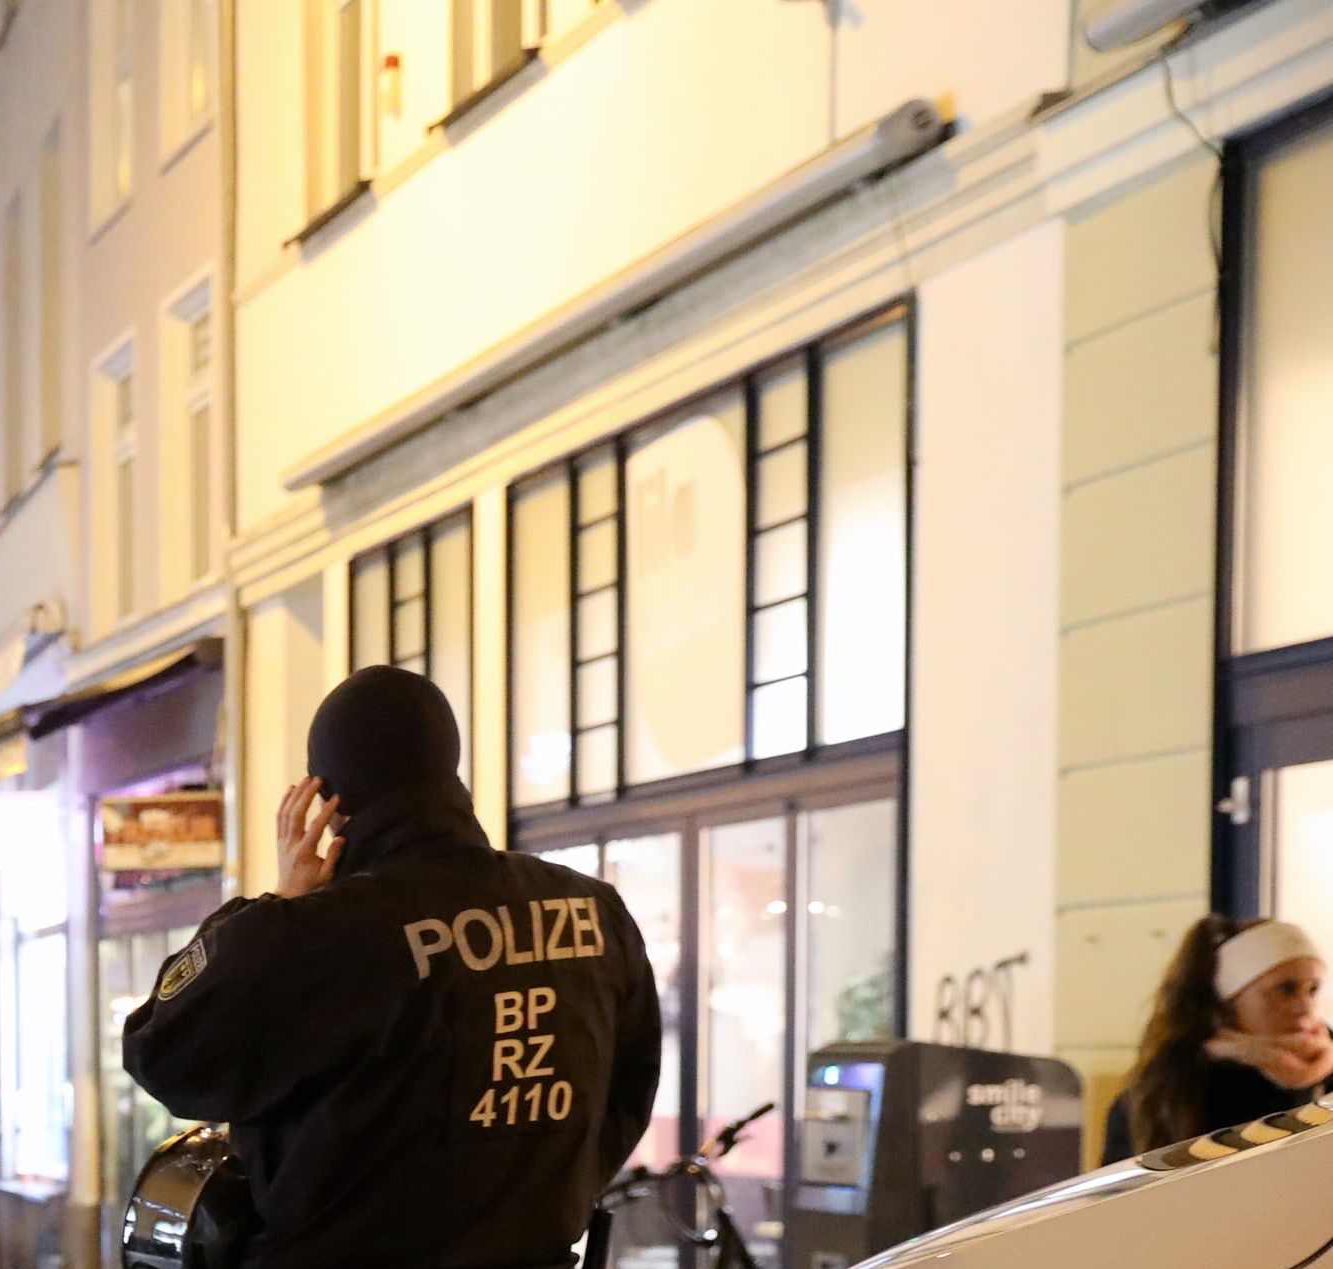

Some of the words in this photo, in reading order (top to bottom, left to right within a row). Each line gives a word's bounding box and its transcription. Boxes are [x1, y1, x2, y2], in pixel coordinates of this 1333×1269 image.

[403, 896, 605, 981] POLIZEI
[494, 986, 558, 1035] BP
[492, 1034, 556, 1082] RZ
[469, 1080, 574, 1128] 4110
